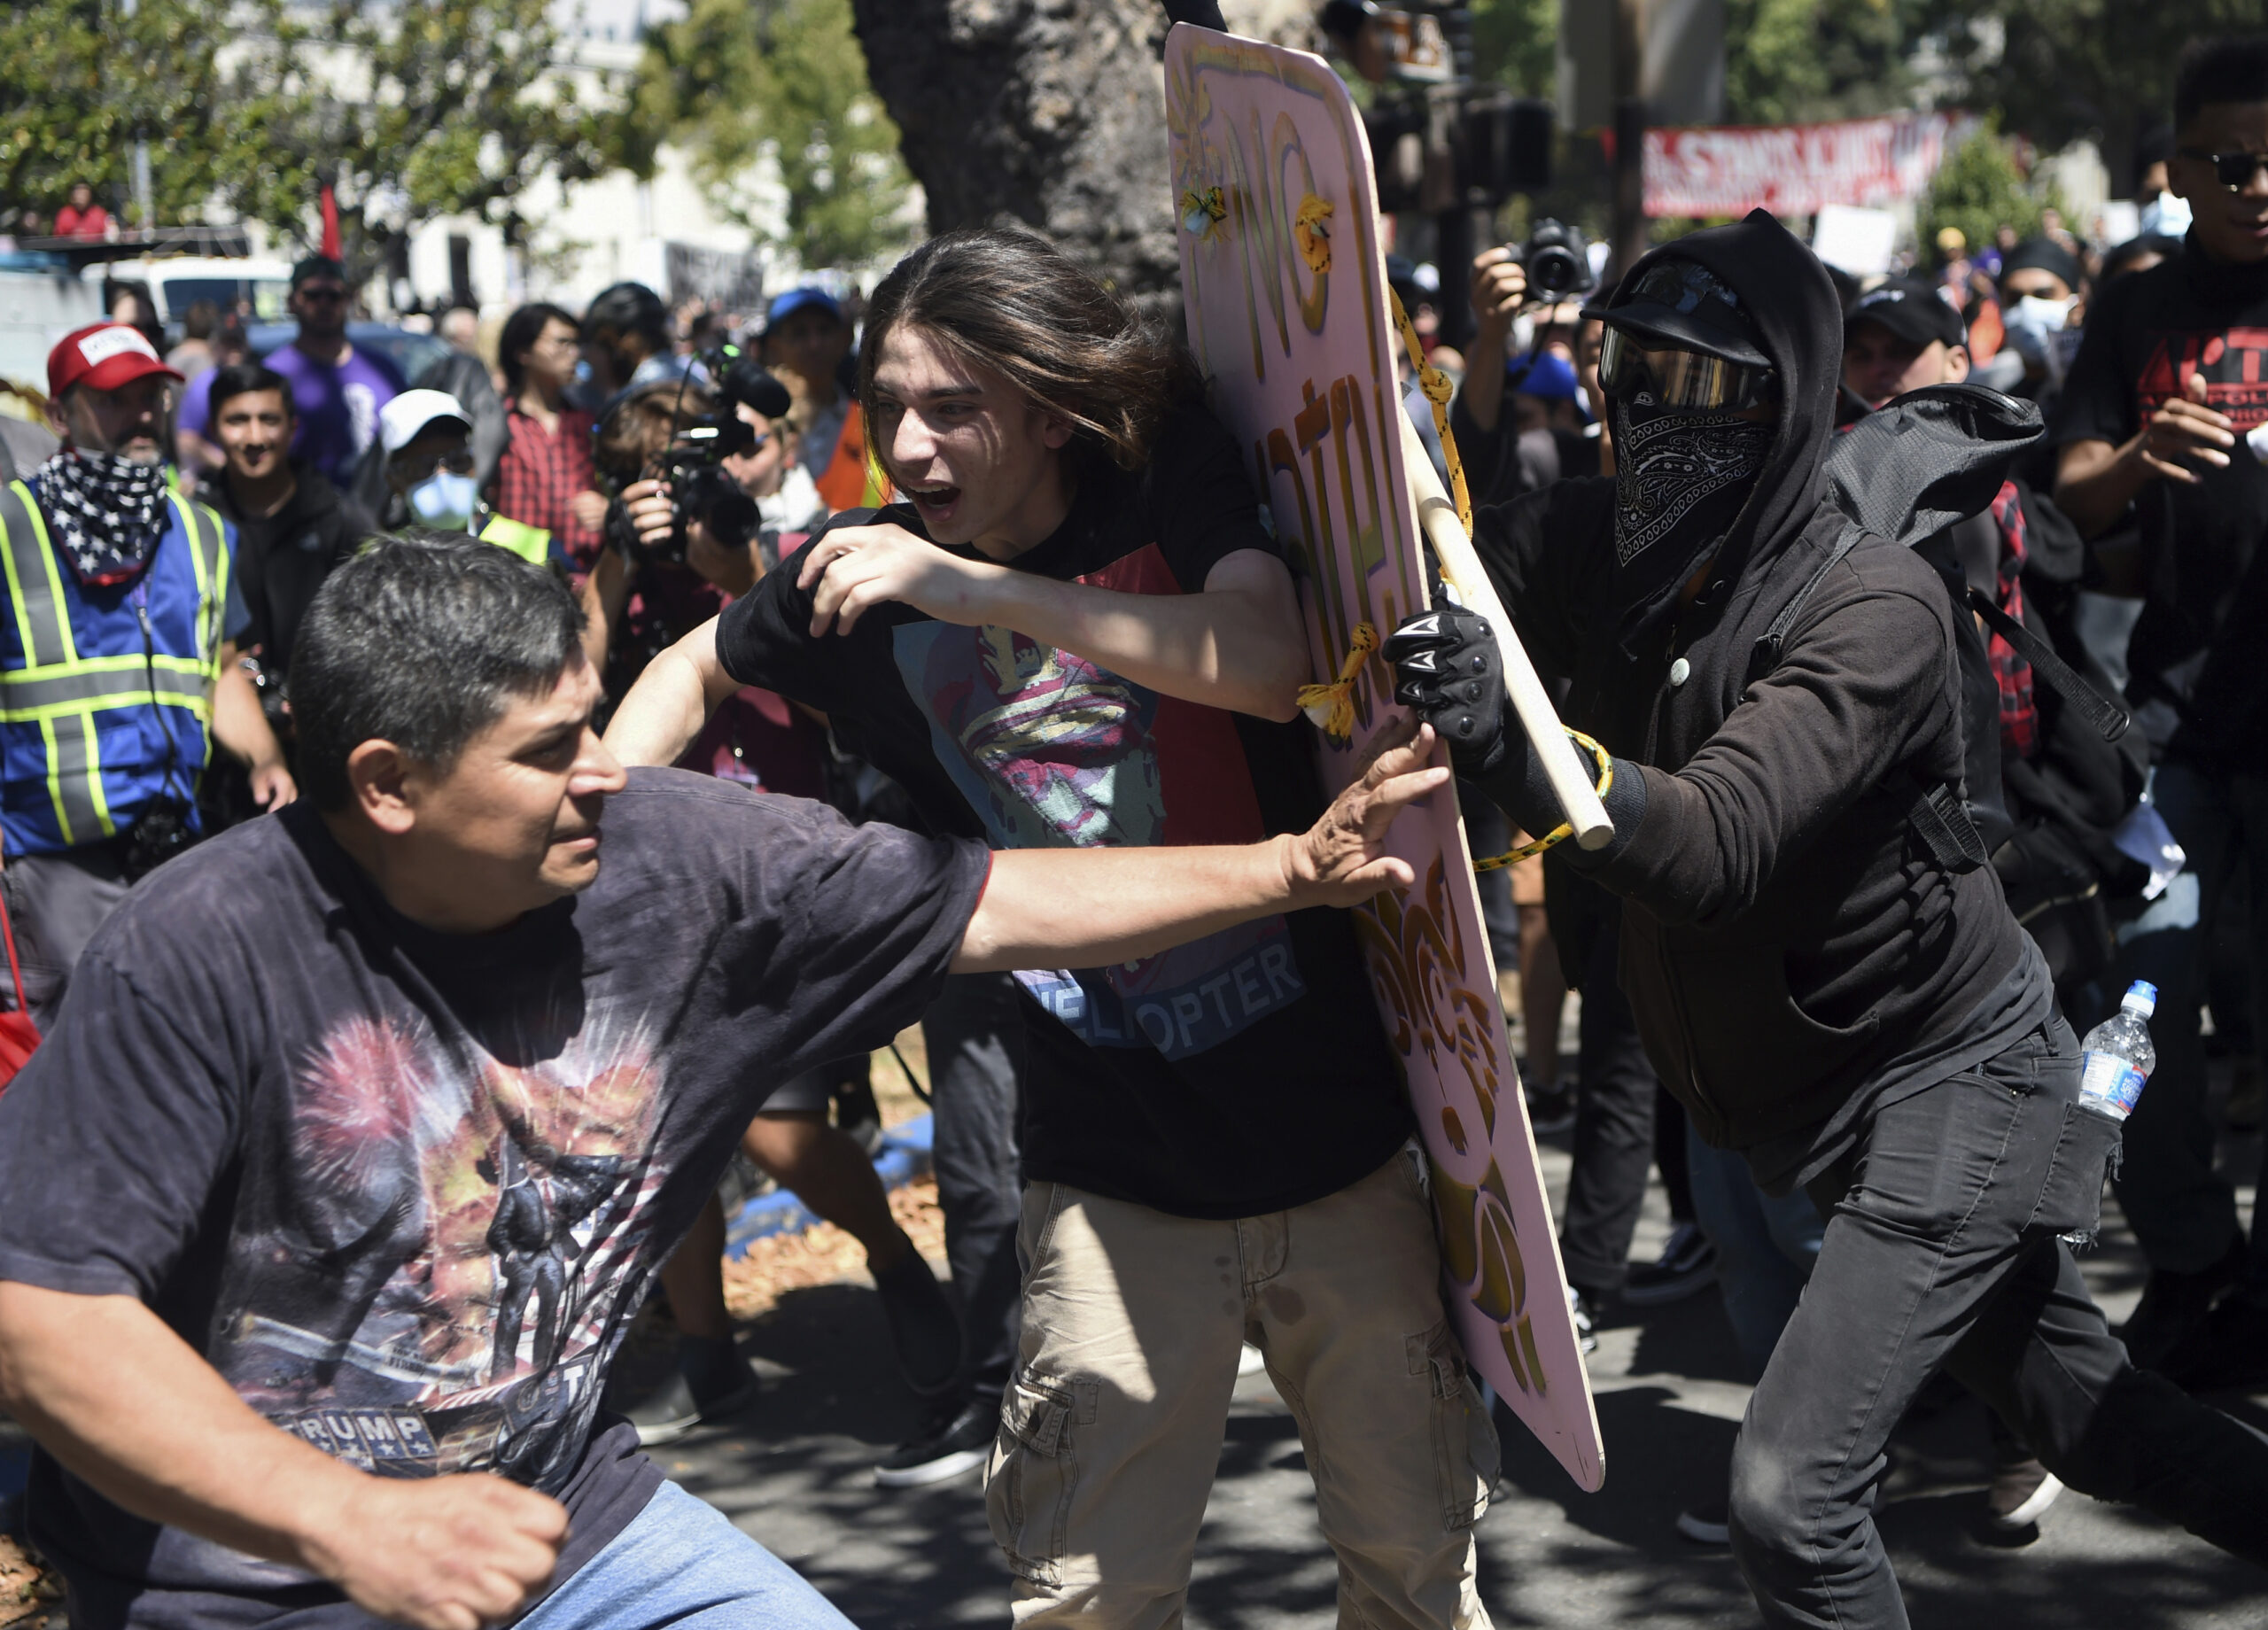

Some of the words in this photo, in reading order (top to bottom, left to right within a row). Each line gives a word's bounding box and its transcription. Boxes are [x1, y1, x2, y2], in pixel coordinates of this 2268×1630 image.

[1220, 105, 1329, 384] NO
[2207, 391, 2268, 406] POL
[1040, 942, 1302, 1055] ELIOPTER
[279, 1415, 423, 1441] RUMP
